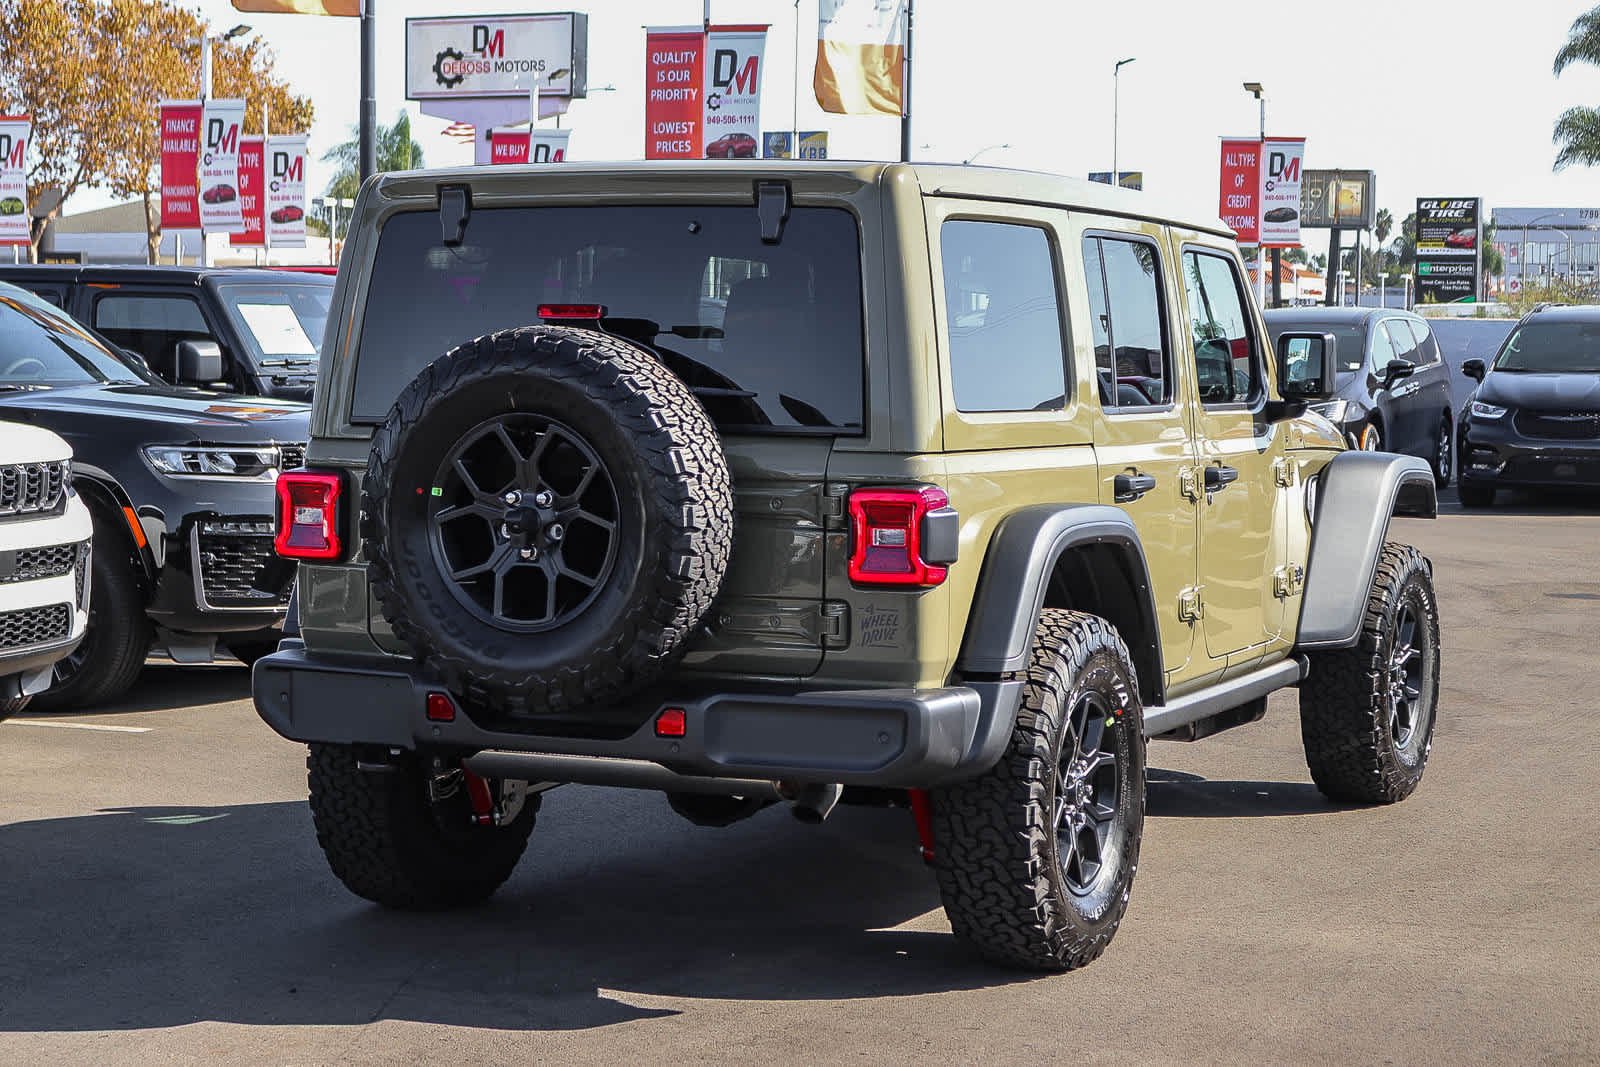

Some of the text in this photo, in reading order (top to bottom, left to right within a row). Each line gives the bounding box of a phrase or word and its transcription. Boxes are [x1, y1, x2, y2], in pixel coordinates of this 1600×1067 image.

[473, 25, 504, 58] DM
[652, 52, 697, 65] QUALITY
[442, 60, 546, 75] DEBOSS MOTORS
[713, 49, 759, 95] DM
[657, 71, 690, 82] IS OUR
[650, 88, 698, 102] PRIORITY
[166, 119, 195, 133] FINANCE
[653, 122, 696, 134] LOWEST
[208, 118, 239, 154] DM
[162, 139, 197, 153] AVAILABLE
[495, 144, 526, 157] WE BUY
[656, 140, 692, 153] PRICES
[243, 152, 259, 168] TYPE
[1225, 153, 1256, 167] ALL TYPE
[1269, 152, 1300, 182] DM
[240, 174, 248, 190] OF
[1234, 174, 1245, 188] OF
[1226, 194, 1252, 208] CREDIT
[1428, 209, 1466, 218] TIRE
[1422, 265, 1473, 274] enterprise
[861, 614, 898, 632] WHEEL
[861, 628, 898, 648] DRIVE
